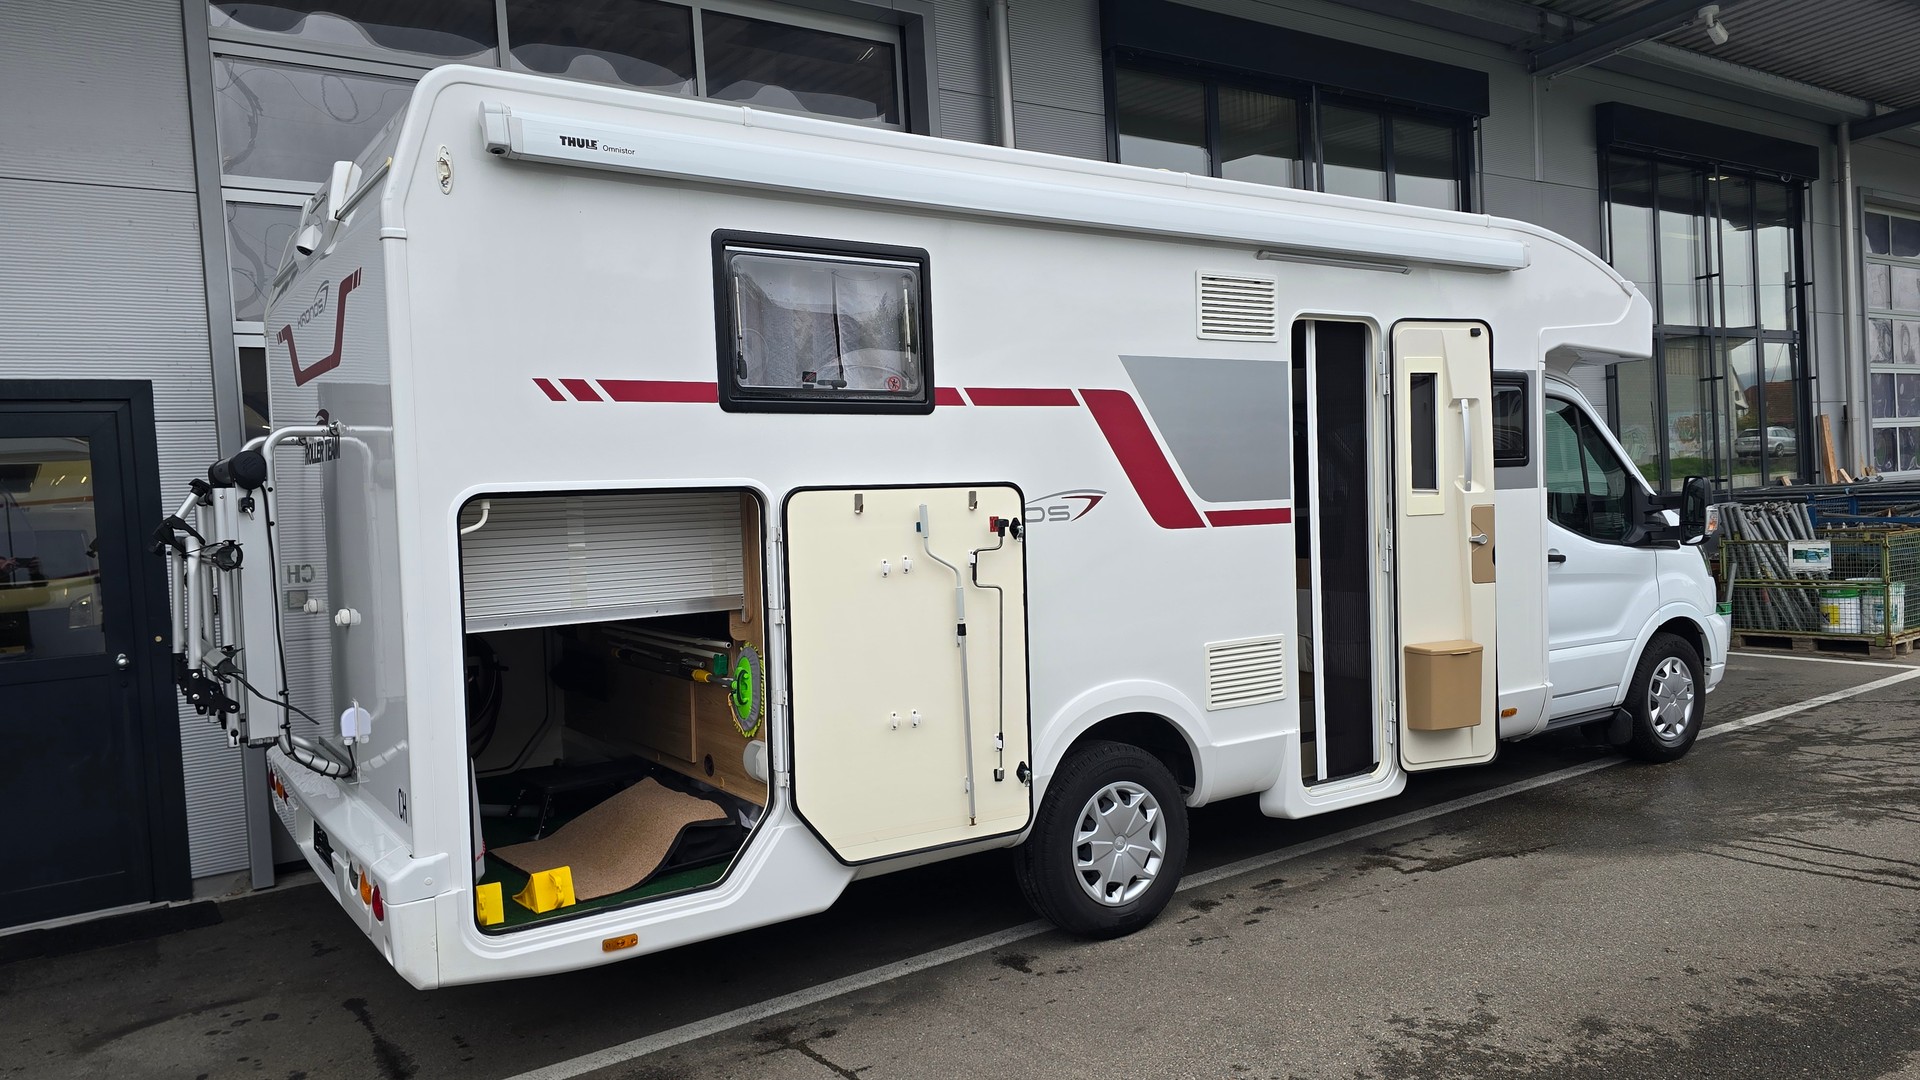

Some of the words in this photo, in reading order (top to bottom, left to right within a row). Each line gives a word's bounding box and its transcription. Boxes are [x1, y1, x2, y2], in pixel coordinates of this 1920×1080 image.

[559, 135, 599, 150] THULE
[602, 144, 635, 155] Omnistor
[398, 788, 408, 824] CH
